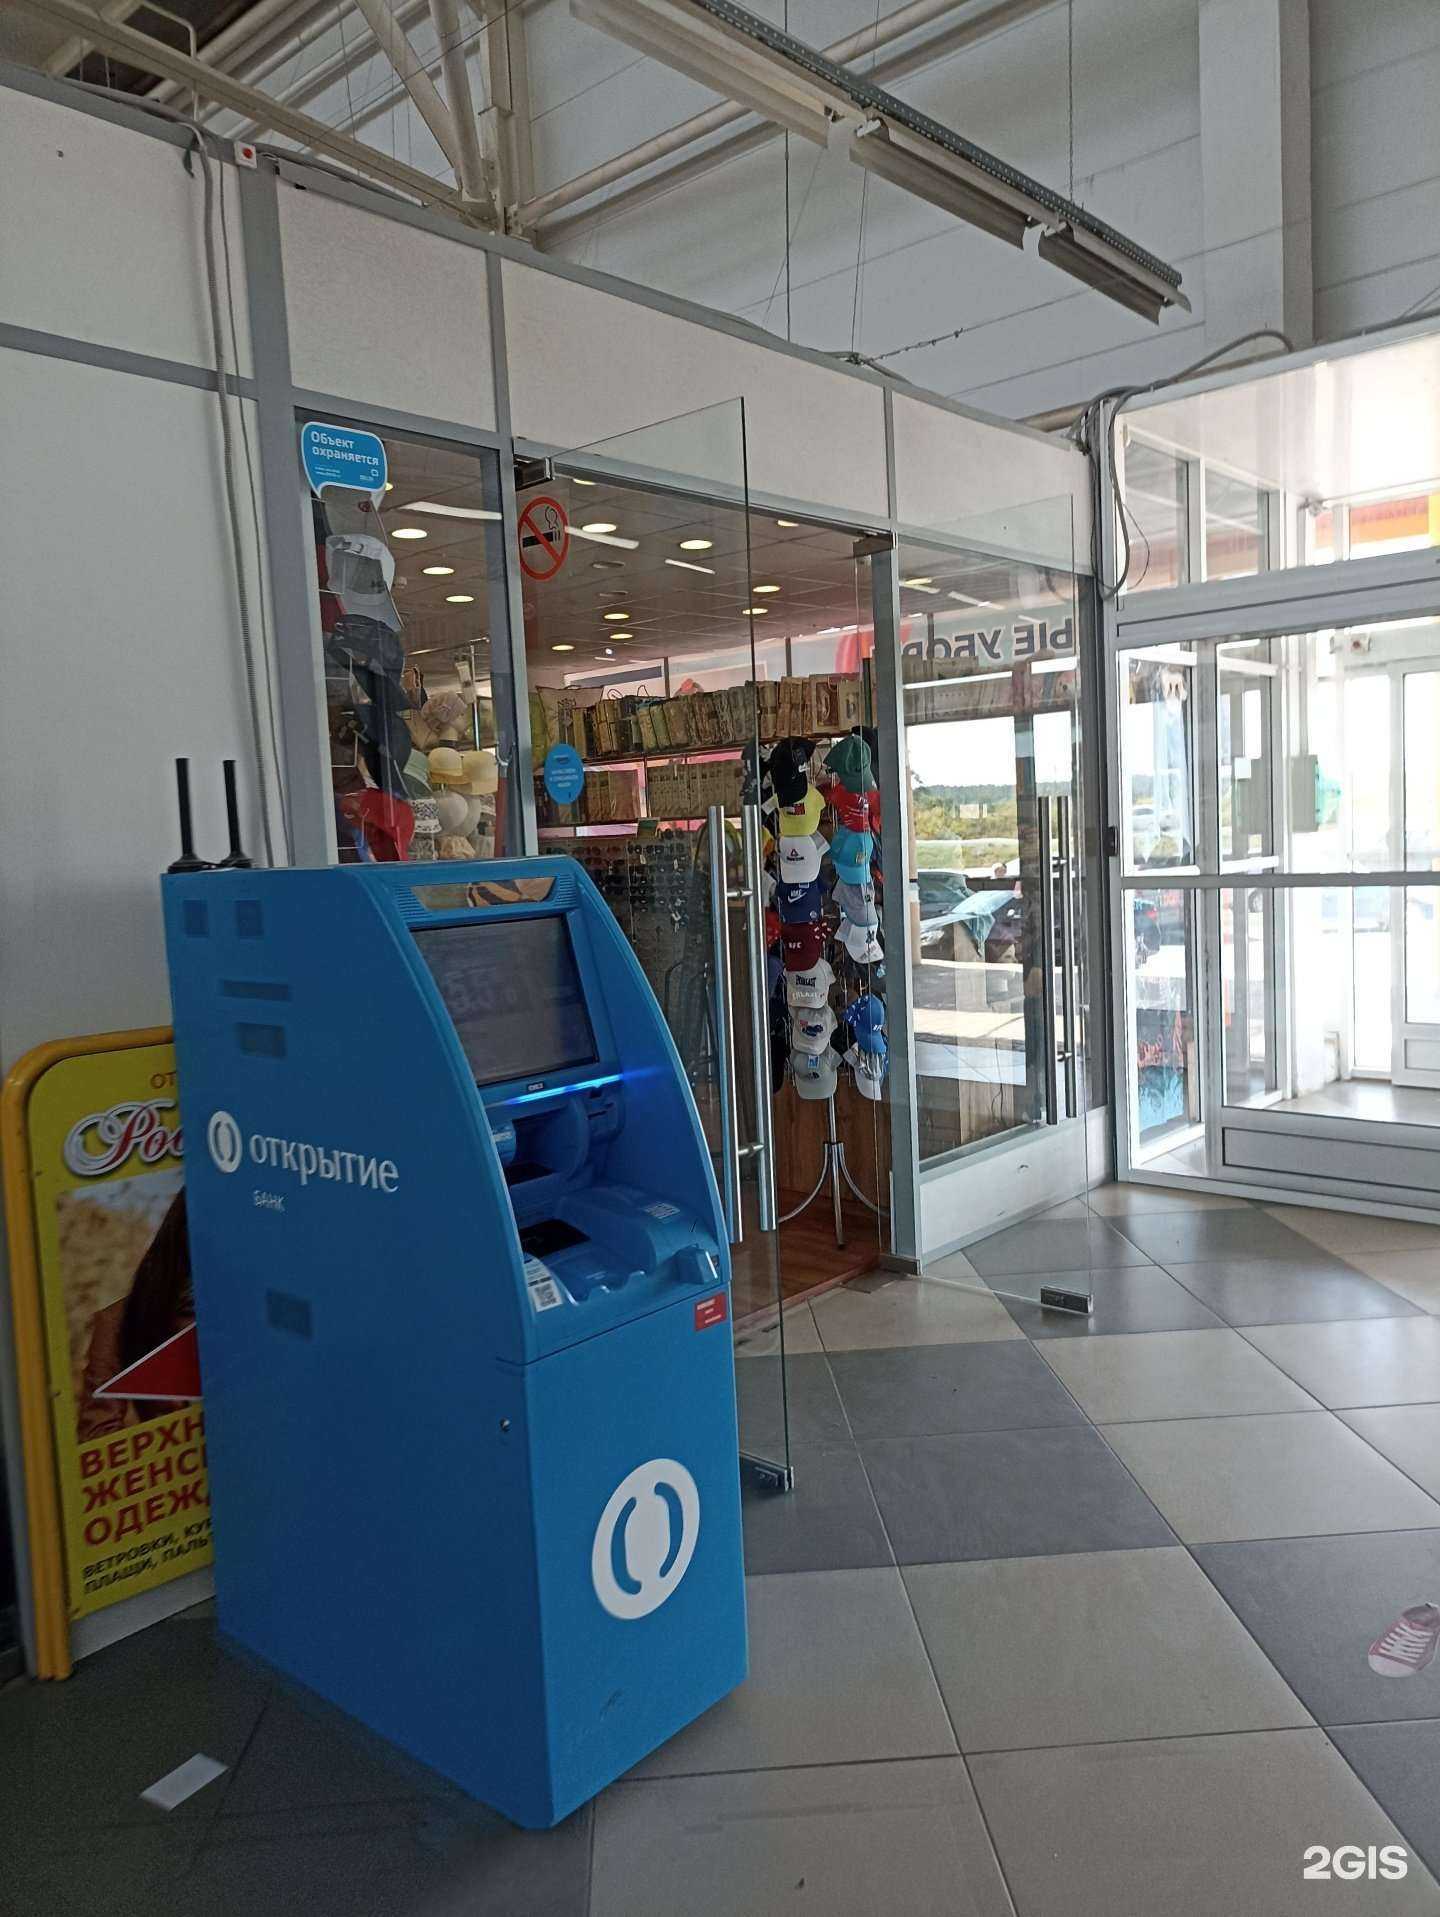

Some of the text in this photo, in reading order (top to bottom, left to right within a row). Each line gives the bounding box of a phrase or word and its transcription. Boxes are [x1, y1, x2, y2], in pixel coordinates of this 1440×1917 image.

[311, 446, 379, 466] охраняется
[249, 1134, 400, 1194] открытие
[84, 1478, 211, 1547] ОДЕЖ
